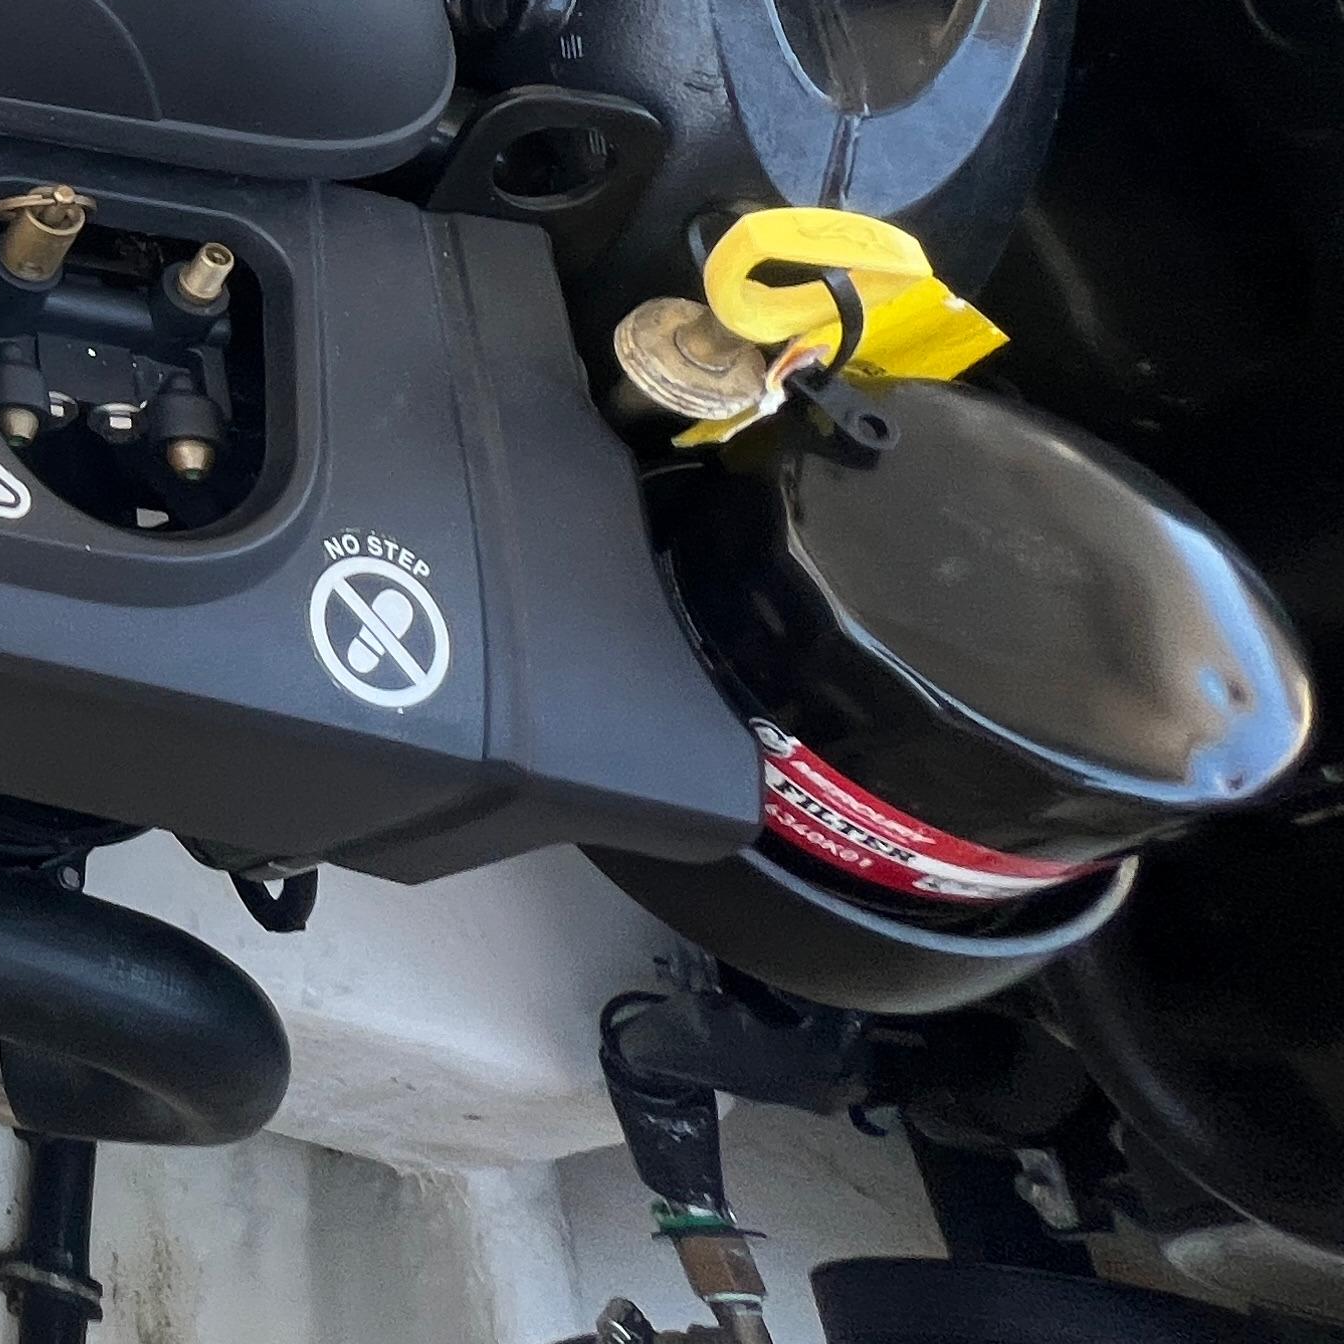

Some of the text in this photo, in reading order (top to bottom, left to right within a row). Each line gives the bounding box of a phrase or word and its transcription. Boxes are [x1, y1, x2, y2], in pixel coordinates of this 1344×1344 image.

[324, 534, 431, 577] NO STEP
[773, 775, 914, 862] FILTER
